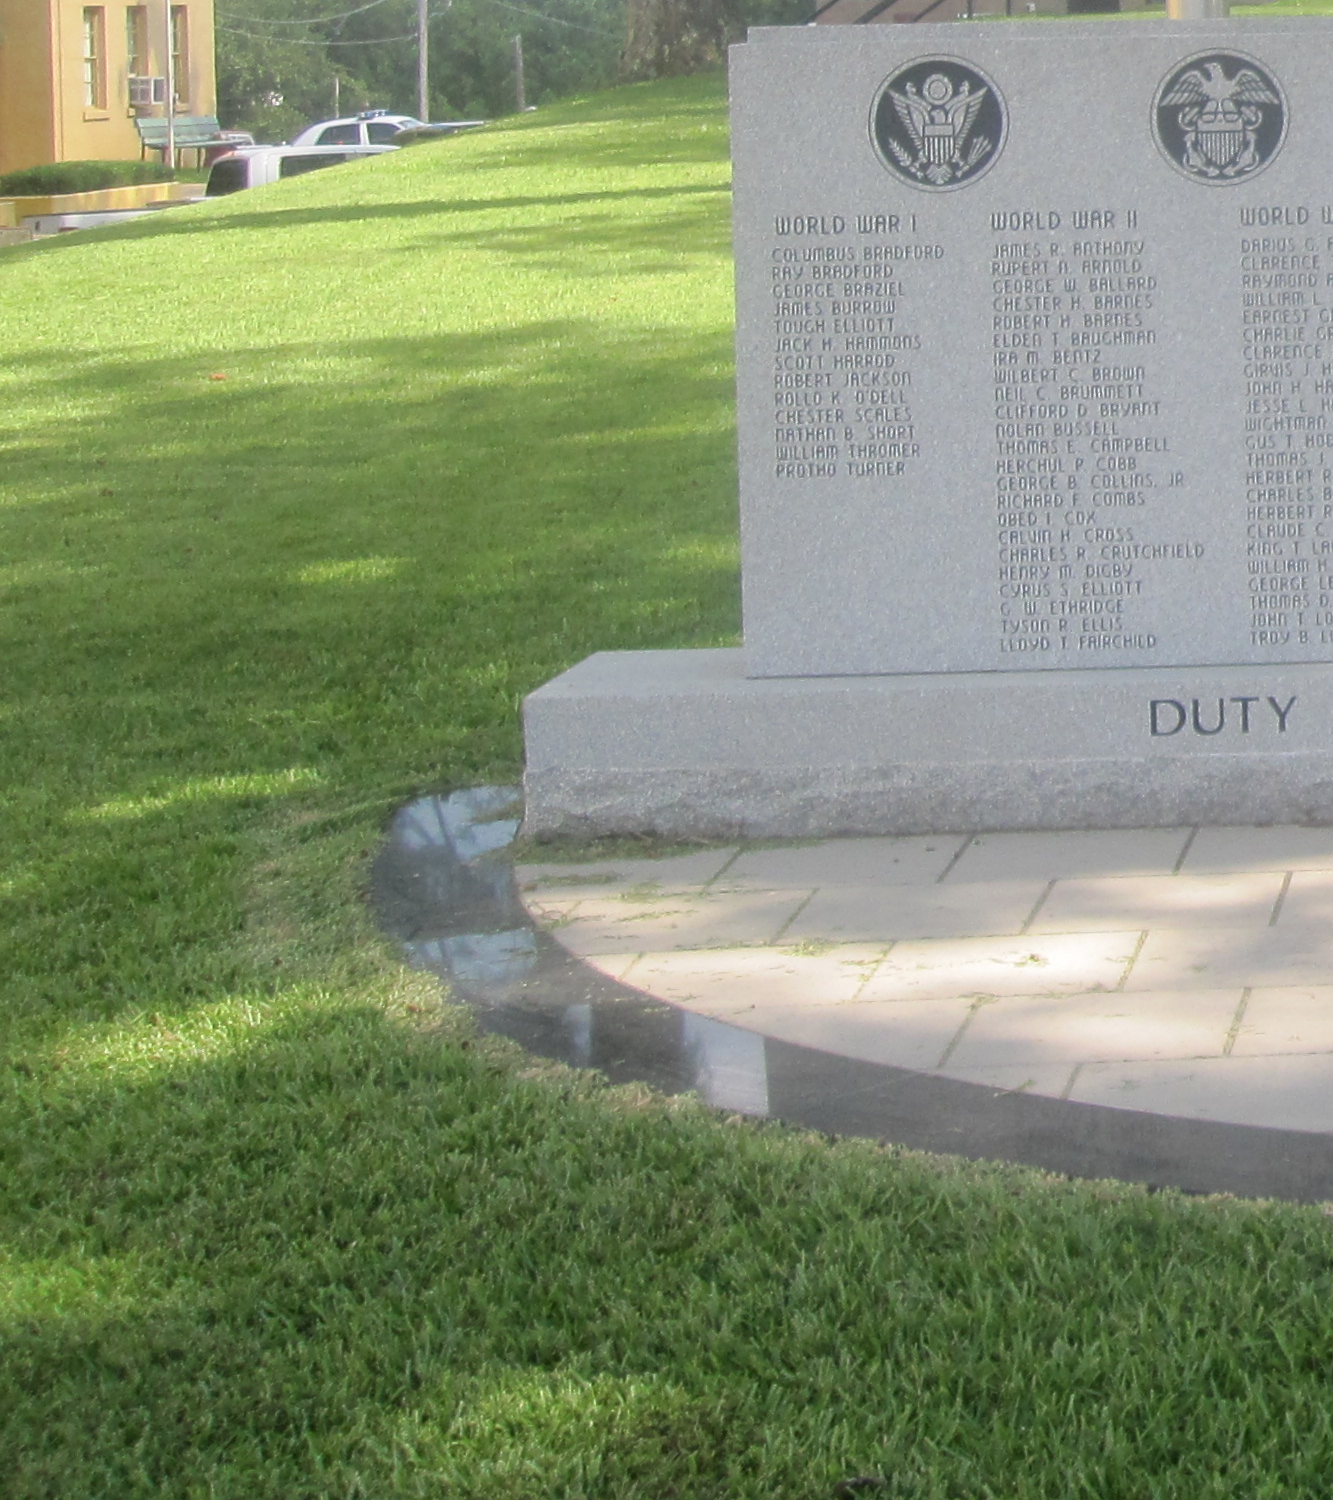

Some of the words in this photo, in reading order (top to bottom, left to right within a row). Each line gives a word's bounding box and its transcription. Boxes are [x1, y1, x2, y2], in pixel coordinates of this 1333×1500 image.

[776, 216, 845, 235] WORLD
[857, 214, 901, 233] WAR
[992, 211, 1060, 230] WORLD
[1073, 210, 1115, 229] WAR
[1127, 210, 1137, 228] II
[1240, 206, 1309, 226] WORLD
[772, 246, 854, 262] COLUMBUS
[864, 244, 945, 260] BRADFORD
[994, 242, 1043, 257] JAMES
[1073, 239, 1143, 255] ANTHONY
[772, 264, 805, 280] RAY
[813, 262, 893, 279] BRADFORD
[773, 282, 836, 298] GEORGE
[844, 280, 905, 297] BRAZIEL
[774, 300, 824, 316] JAMES
[832, 299, 896, 315] BURROW
[774, 318, 825, 334] TOUGH
[835, 317, 895, 333] ELLIOTT
[1243, 326, 1305, 342] CHARLIE
[775, 336, 812, 352] JACK
[846, 334, 921, 349] HAMMONS
[775, 372, 835, 388] ROBERT
[843, 370, 911, 386] JACKSON
[994, 368, 1058, 384] WILBERT
[1092, 366, 1144, 382] BROWN
[775, 408, 845, 424] CHESTER
[855, 406, 912, 422] SCALES
[996, 403, 1068, 419] CLIFFORD
[1101, 401, 1160, 417] BRYANT
[776, 426, 837, 441] NATHAN
[868, 424, 914, 439] SHORT
[997, 439, 1058, 455] THOMAS
[1090, 437, 1169, 453] CAMPBELL
[1149, 695, 1297, 736] DUTY
